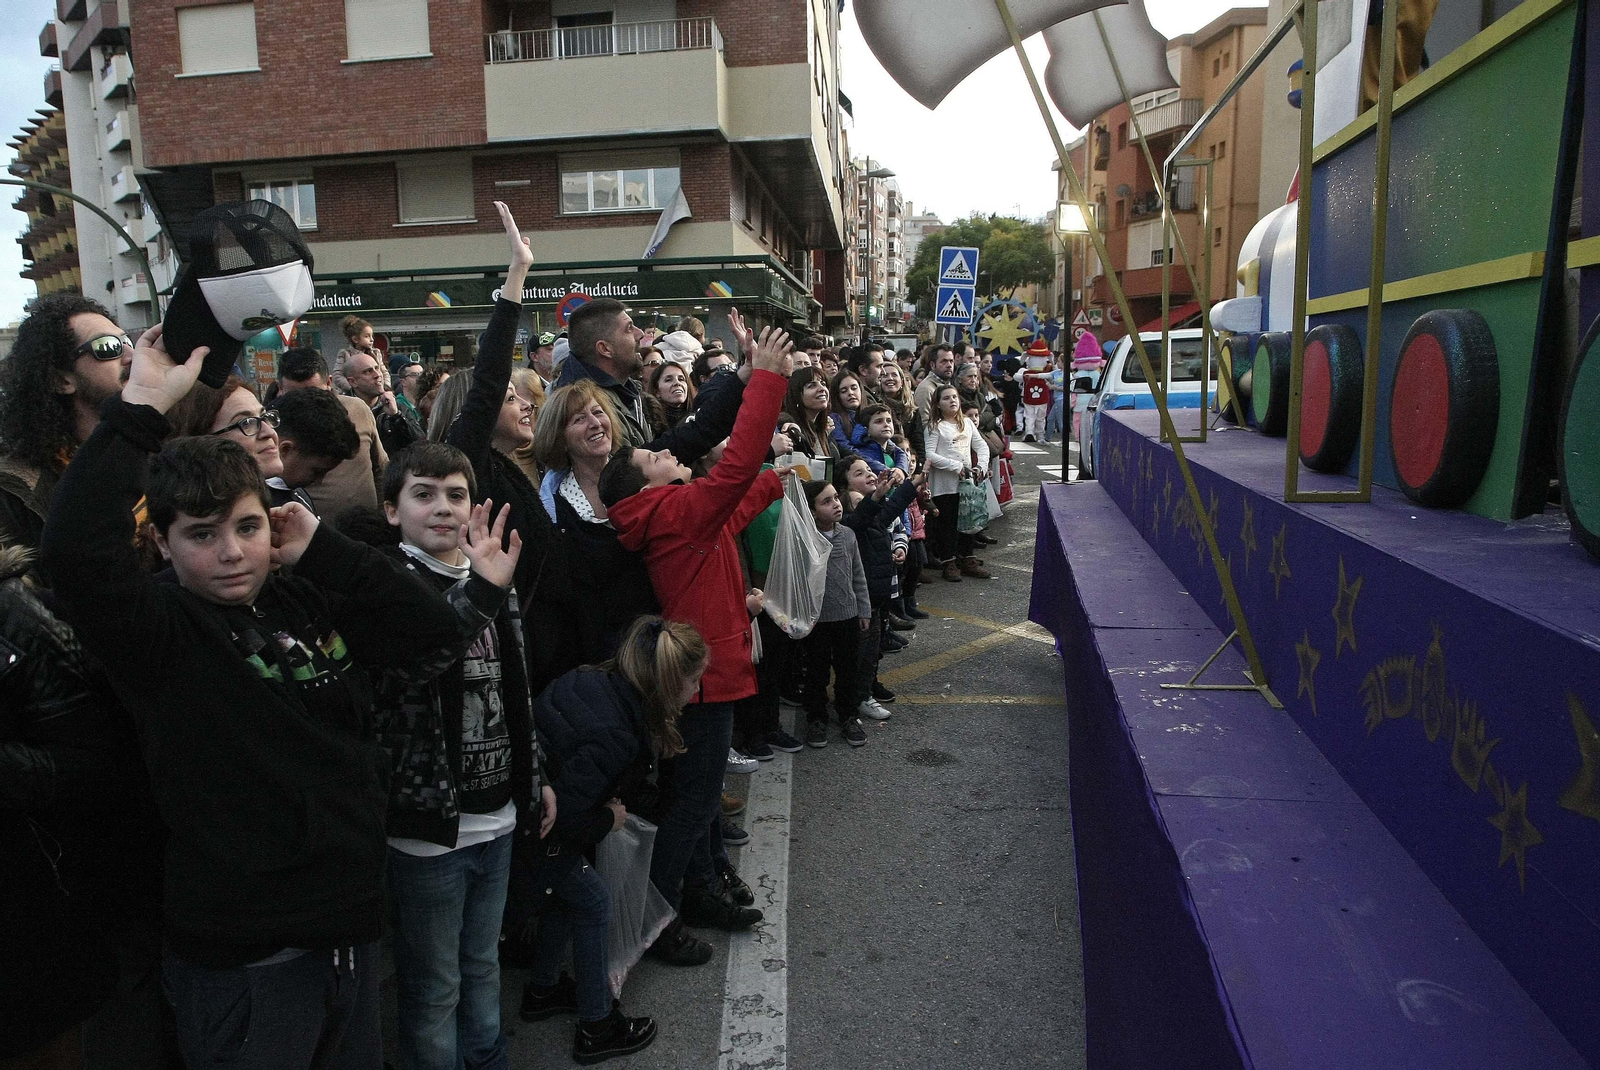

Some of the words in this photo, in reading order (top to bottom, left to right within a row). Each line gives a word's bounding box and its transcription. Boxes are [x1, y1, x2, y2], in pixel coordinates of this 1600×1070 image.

[508, 284, 566, 299] inturas
[569, 282, 639, 297] Andalucía
[310, 293, 362, 310] ndalucía
